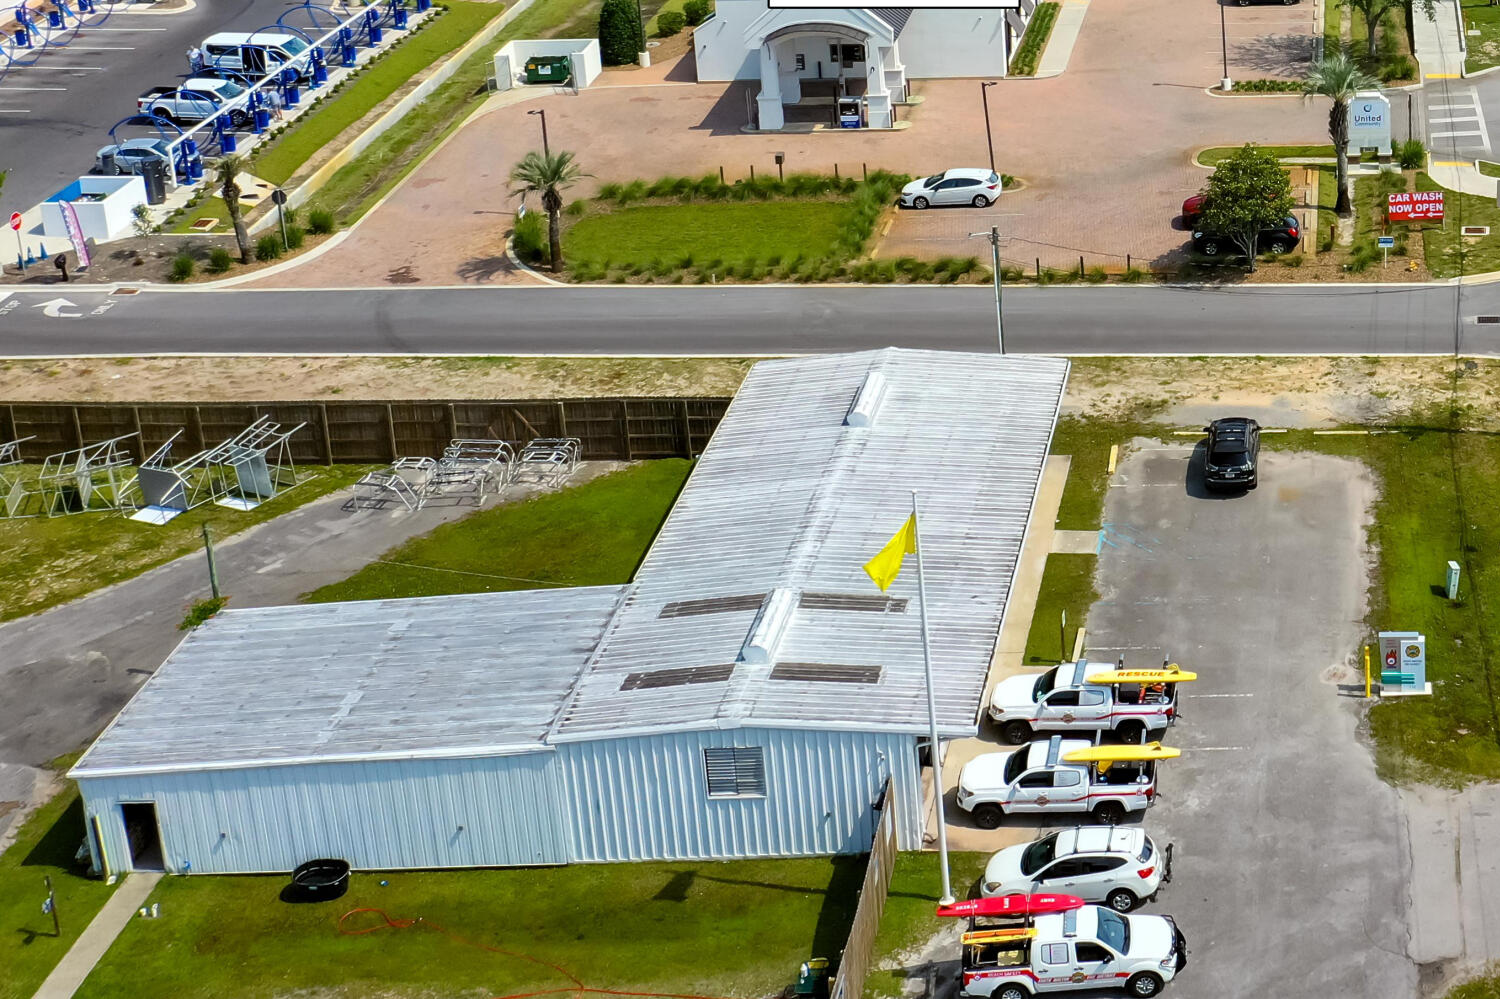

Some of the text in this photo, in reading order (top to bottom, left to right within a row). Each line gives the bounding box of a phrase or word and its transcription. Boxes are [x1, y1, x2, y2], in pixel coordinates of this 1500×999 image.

[1388, 192, 1443, 203] CAR WASH
[1388, 202, 1443, 213] NOW OPEN
